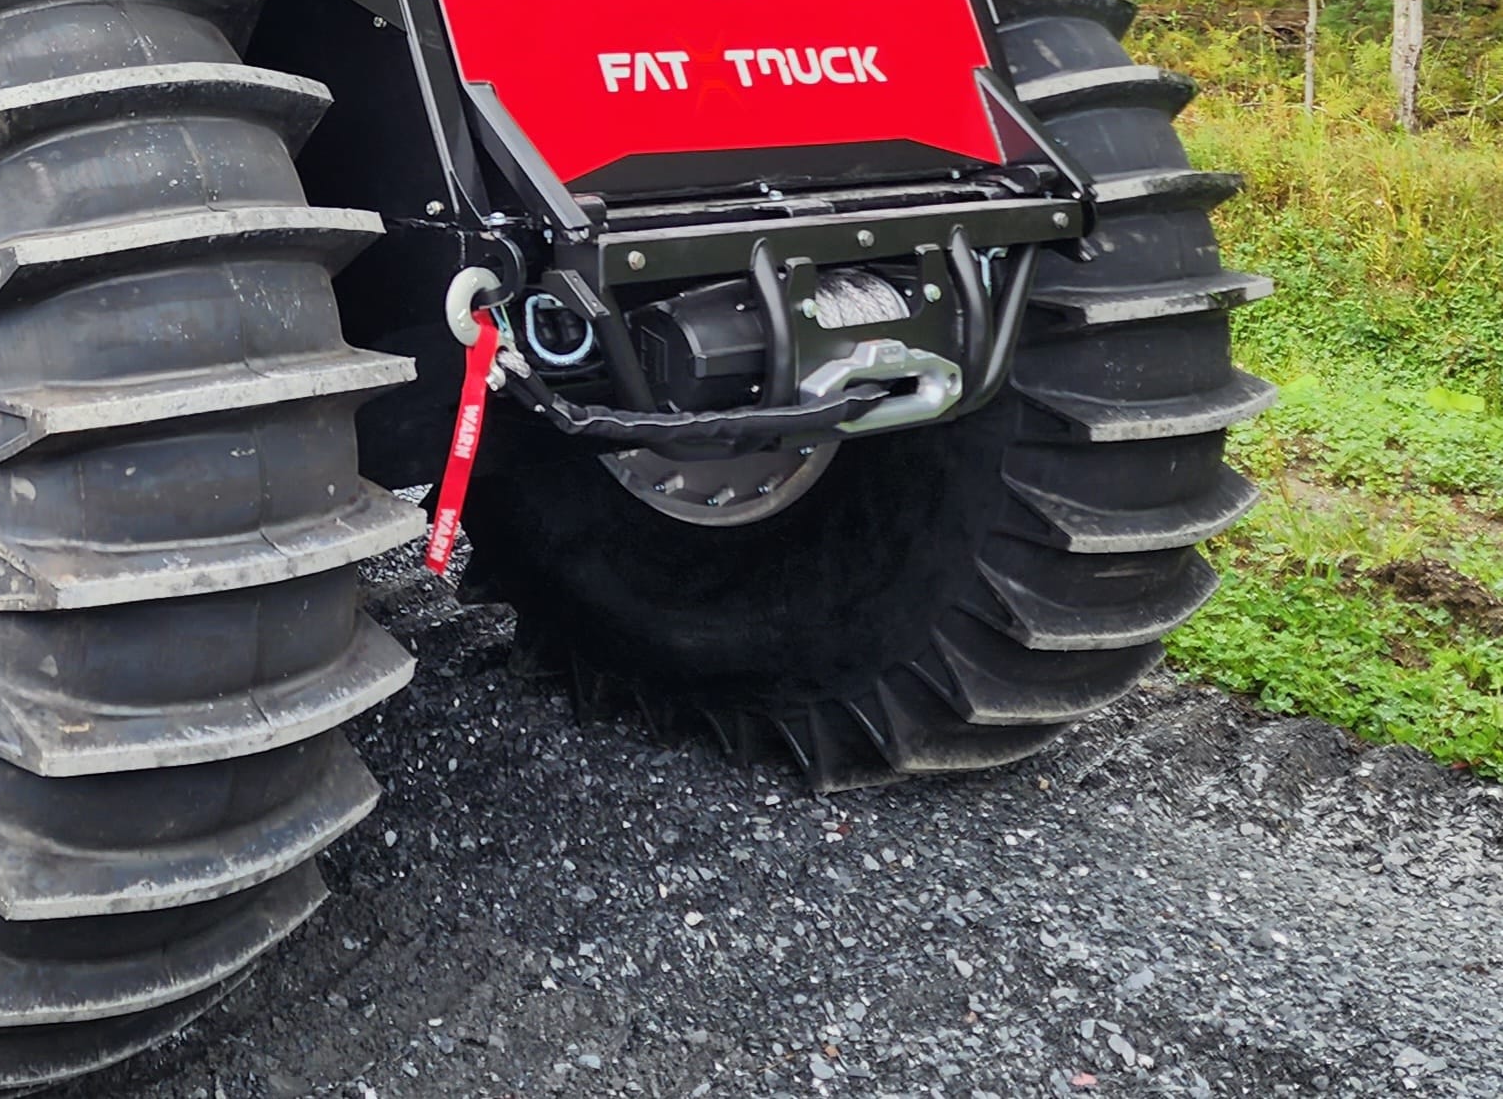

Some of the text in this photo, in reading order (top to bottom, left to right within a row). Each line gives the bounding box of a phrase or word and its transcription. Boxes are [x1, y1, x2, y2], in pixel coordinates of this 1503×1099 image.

[597, 46, 888, 92] FAT TRUCK
[454, 404, 480, 460] WARN
[430, 508, 456, 563] WARN
